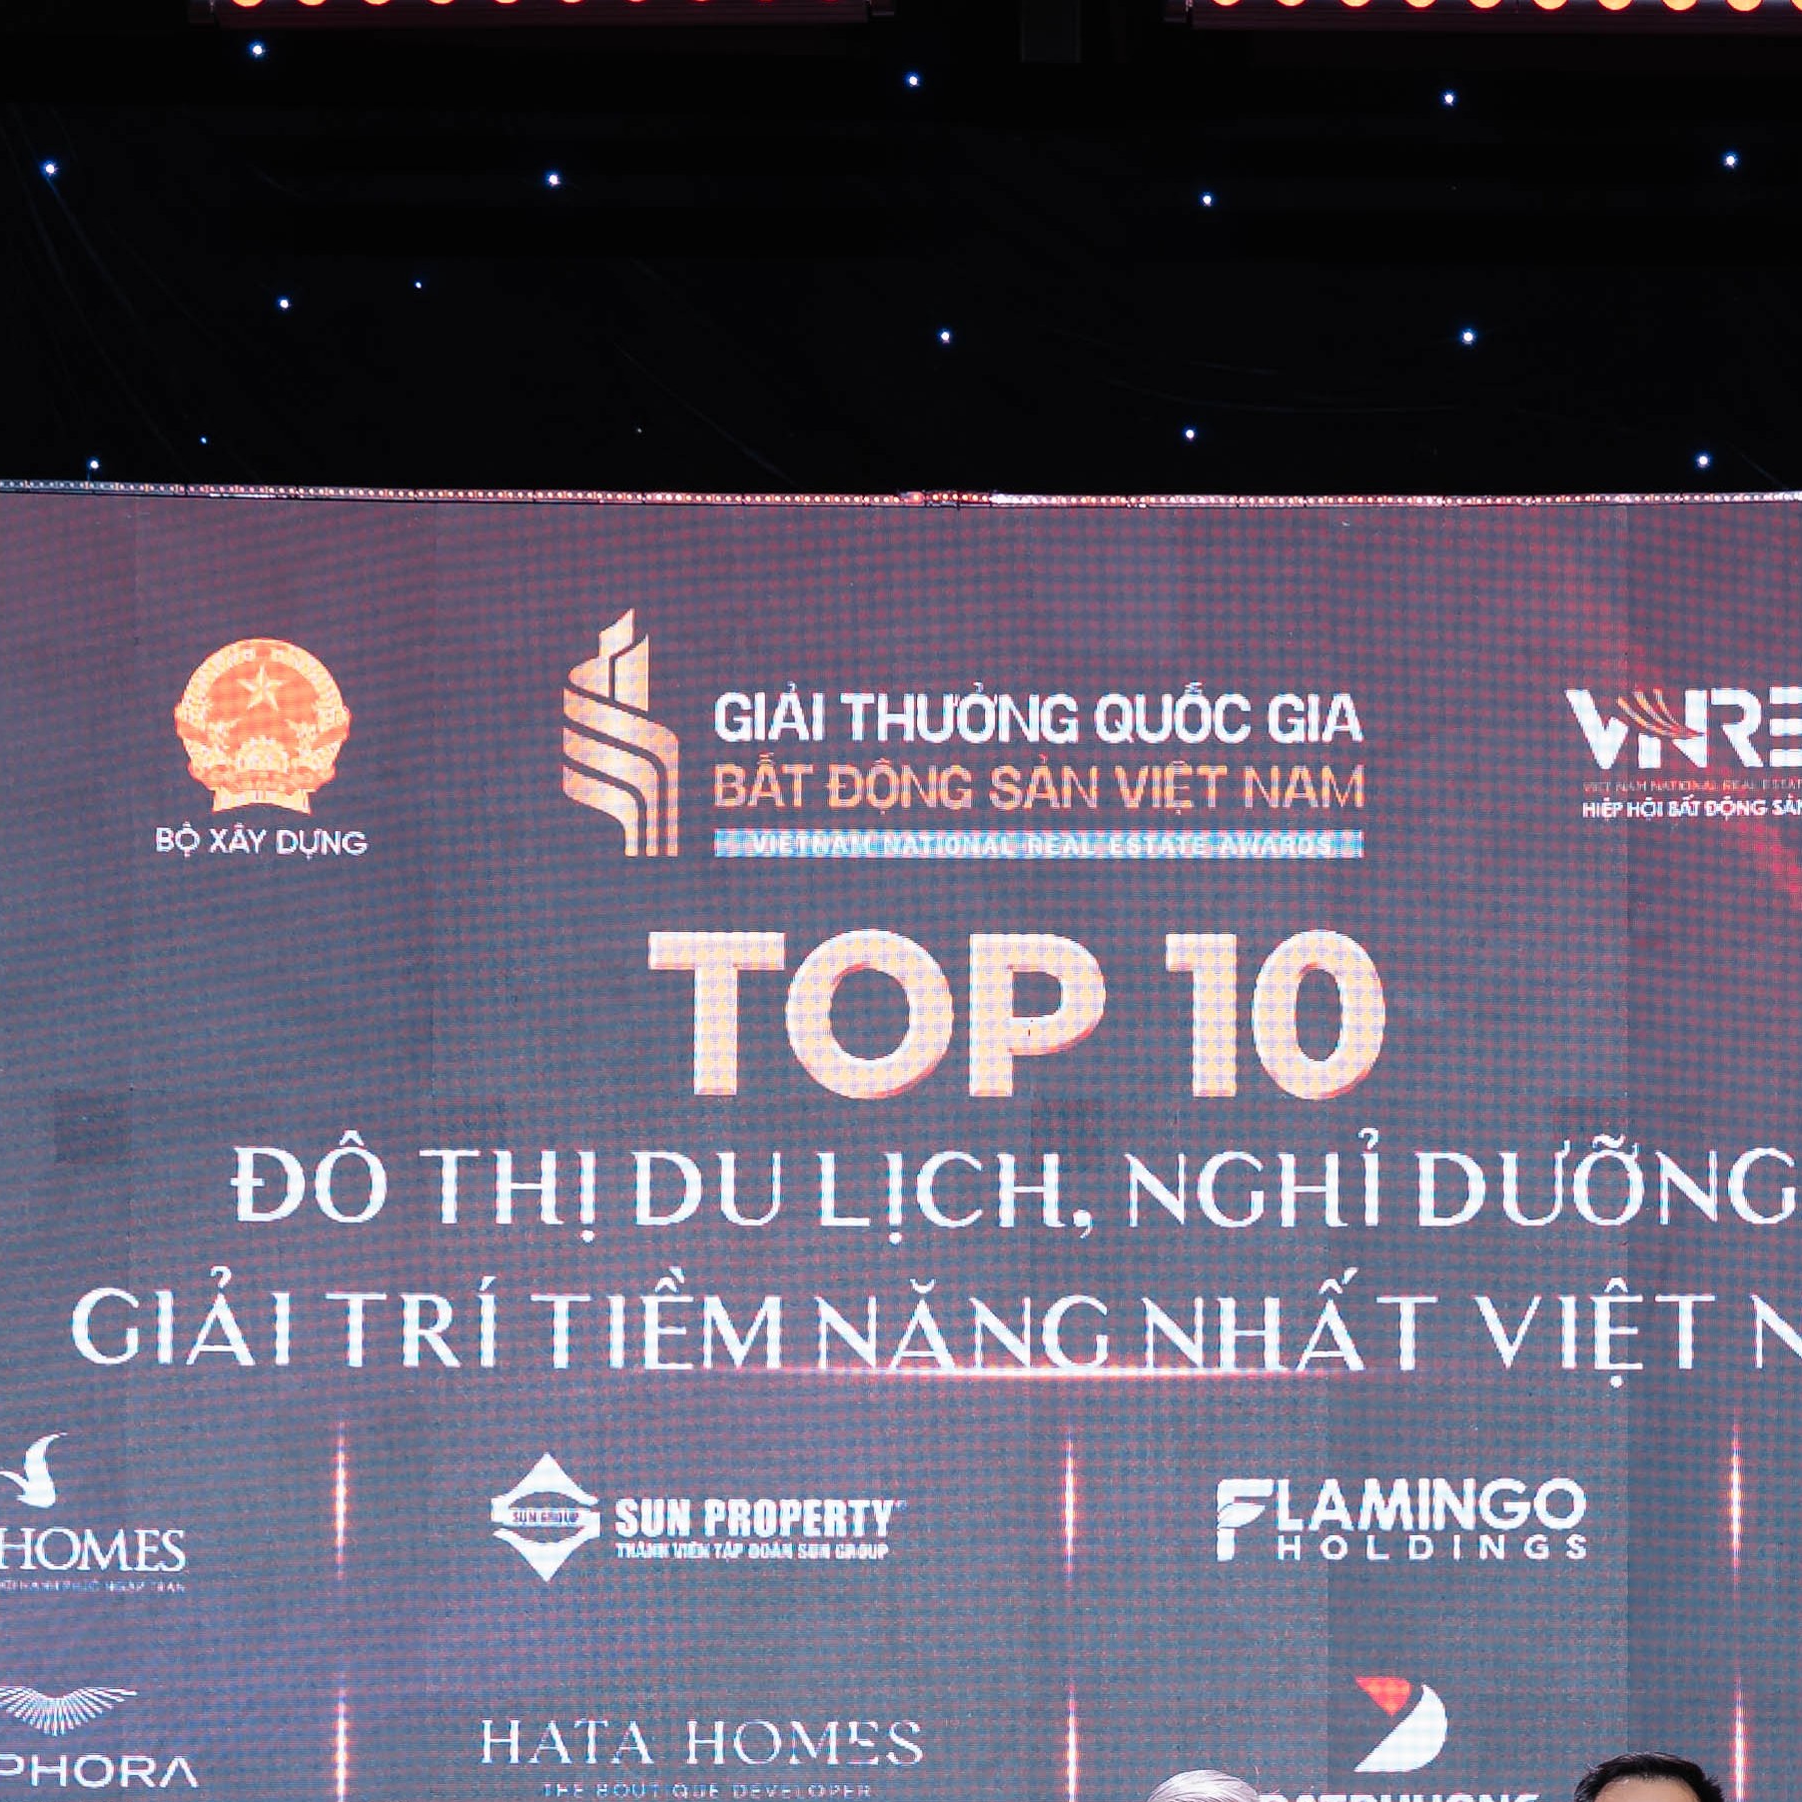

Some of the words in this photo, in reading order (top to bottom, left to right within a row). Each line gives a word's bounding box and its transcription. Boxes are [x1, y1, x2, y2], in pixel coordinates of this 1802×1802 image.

[714, 680, 826, 743] GIẢI
[840, 680, 1079, 744] THƯỞNG
[1094, 682, 1252, 744] QUỐC
[1267, 693, 1364, 743] GIA
[714, 752, 814, 808] BẤT
[826, 758, 973, 816] ĐỘNG
[989, 753, 1098, 810] SẢN
[1114, 760, 1228, 815] VIỆT
[1244, 765, 1365, 808] NAM
[155, 821, 200, 857] BỘ
[209, 822, 267, 854] XÂY
[276, 828, 369, 860] DỰNG
[648, 929, 1106, 1100] TOP
[1164, 929, 1386, 1101] 10
[229, 1129, 388, 1224] ĐÔ
[419, 1149, 596, 1242] THỊ
[631, 1151, 781, 1226] DU
[817, 1148, 1094, 1243] LỊCH,
[1125, 1127, 1383, 1227] NGHỈ
[71, 1266, 291, 1367] GIẢI
[326, 1275, 497, 1368] TRÍ
[530, 1266, 782, 1370] TIỀM
[815, 1278, 1110, 1371] NĂNG
[1141, 1267, 1439, 1371] NHẤT
[1474, 1276, 1715, 1388] VIỆT
[615, 1498, 690, 1537] SUN
[704, 1498, 895, 1537] PROPERTY
[1216, 1478, 1587, 1562] FLAMINGO
[1276, 1533, 1587, 1561] HOLDINGS
[480, 1718, 655, 1764] HATA
[686, 1718, 924, 1766] HOMES
